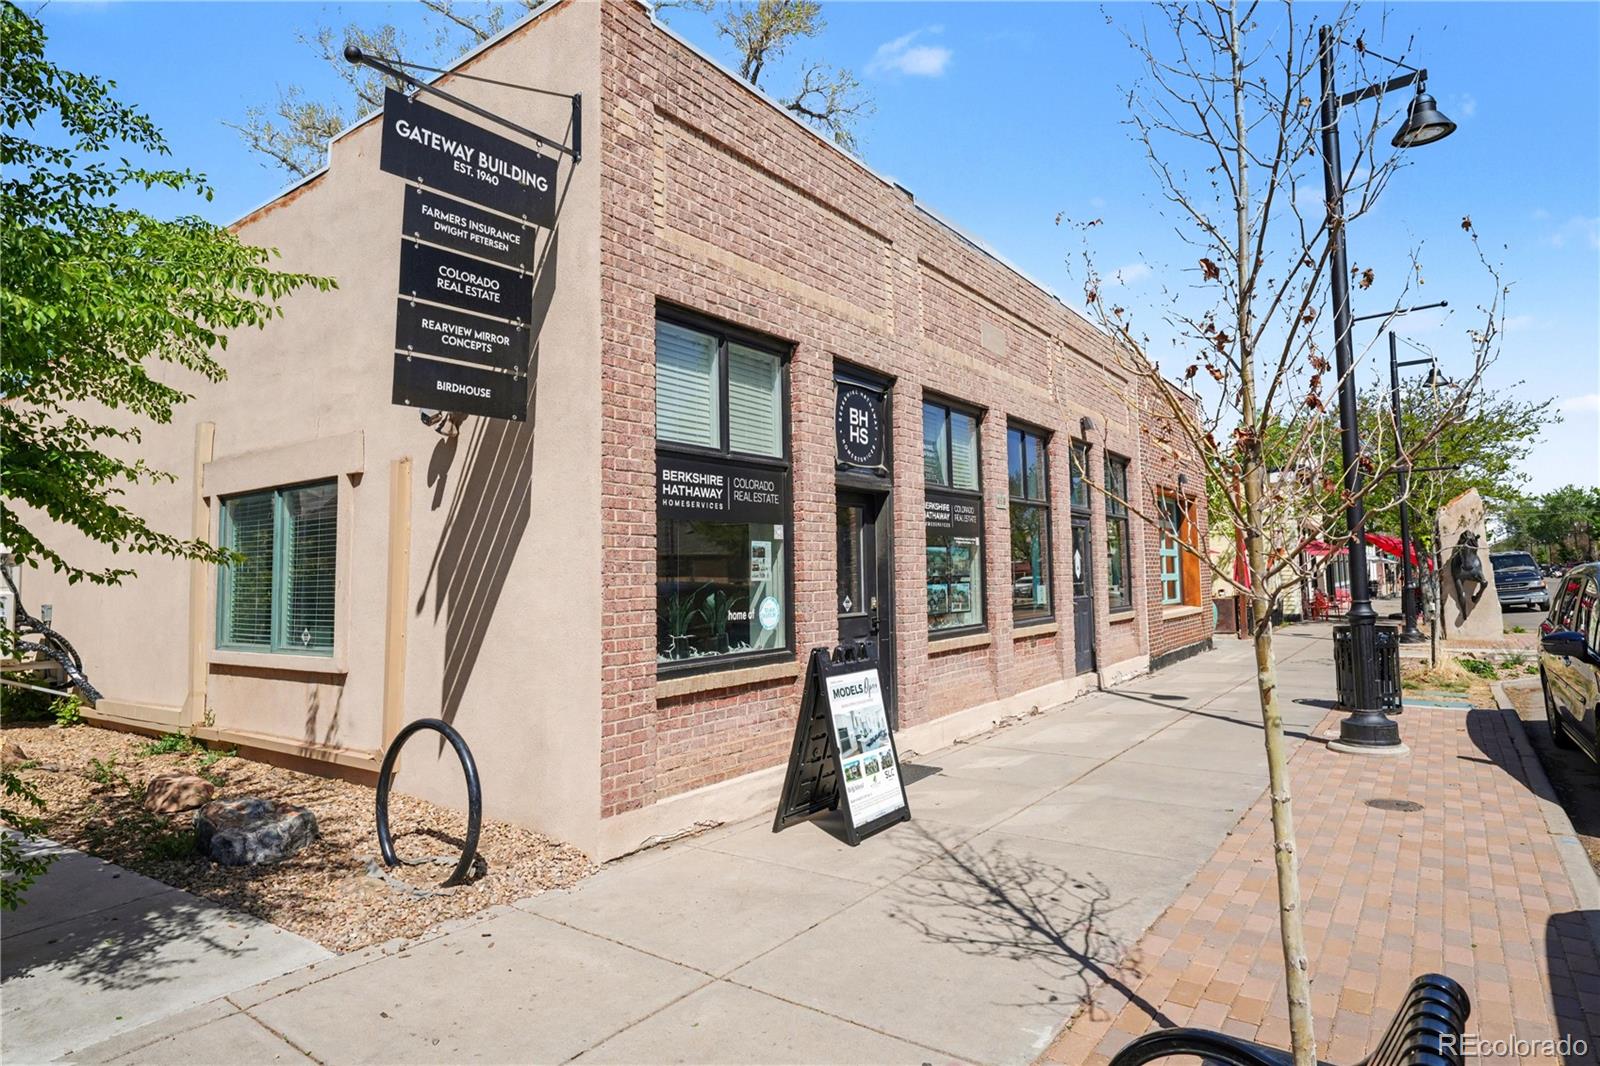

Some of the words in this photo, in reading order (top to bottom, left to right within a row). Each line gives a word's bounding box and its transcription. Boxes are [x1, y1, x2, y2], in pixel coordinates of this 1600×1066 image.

[395, 119, 475, 163] GATEWAY
[479, 151, 549, 193] BUILDING
[453, 162, 474, 178] EST.
[476, 168, 500, 187] 1940
[421, 204, 467, 228] FARMERS
[469, 219, 521, 245] INSURANCE
[434, 221, 468, 241] DWIGHT
[470, 232, 509, 252] PETERSEN
[438, 265, 500, 291] COLORADO
[436, 277, 463, 294] REAL
[465, 285, 501, 303] ESTATE
[421, 318, 472, 338] REARVIEW
[474, 330, 510, 346] MIRROR
[441, 334, 493, 354] CONCEPTS
[436, 380, 492, 399] BIRDHOUSE
[849, 407, 869, 428] BH
[849, 425, 869, 445] HS
[662, 469, 724, 486] BERKSHIRE
[733, 477, 775, 492] COLORADO
[662, 483, 724, 499] HATHAWAY
[733, 490, 752, 502] REAL
[753, 492, 780, 505] ESTATE
[662, 498, 724, 510] HOMESERVICES
[926, 512, 950, 521] ATHAWAY
[727, 609, 747, 621] home
[748, 609, 756, 620] of
[832, 684, 863, 699] MODELS
